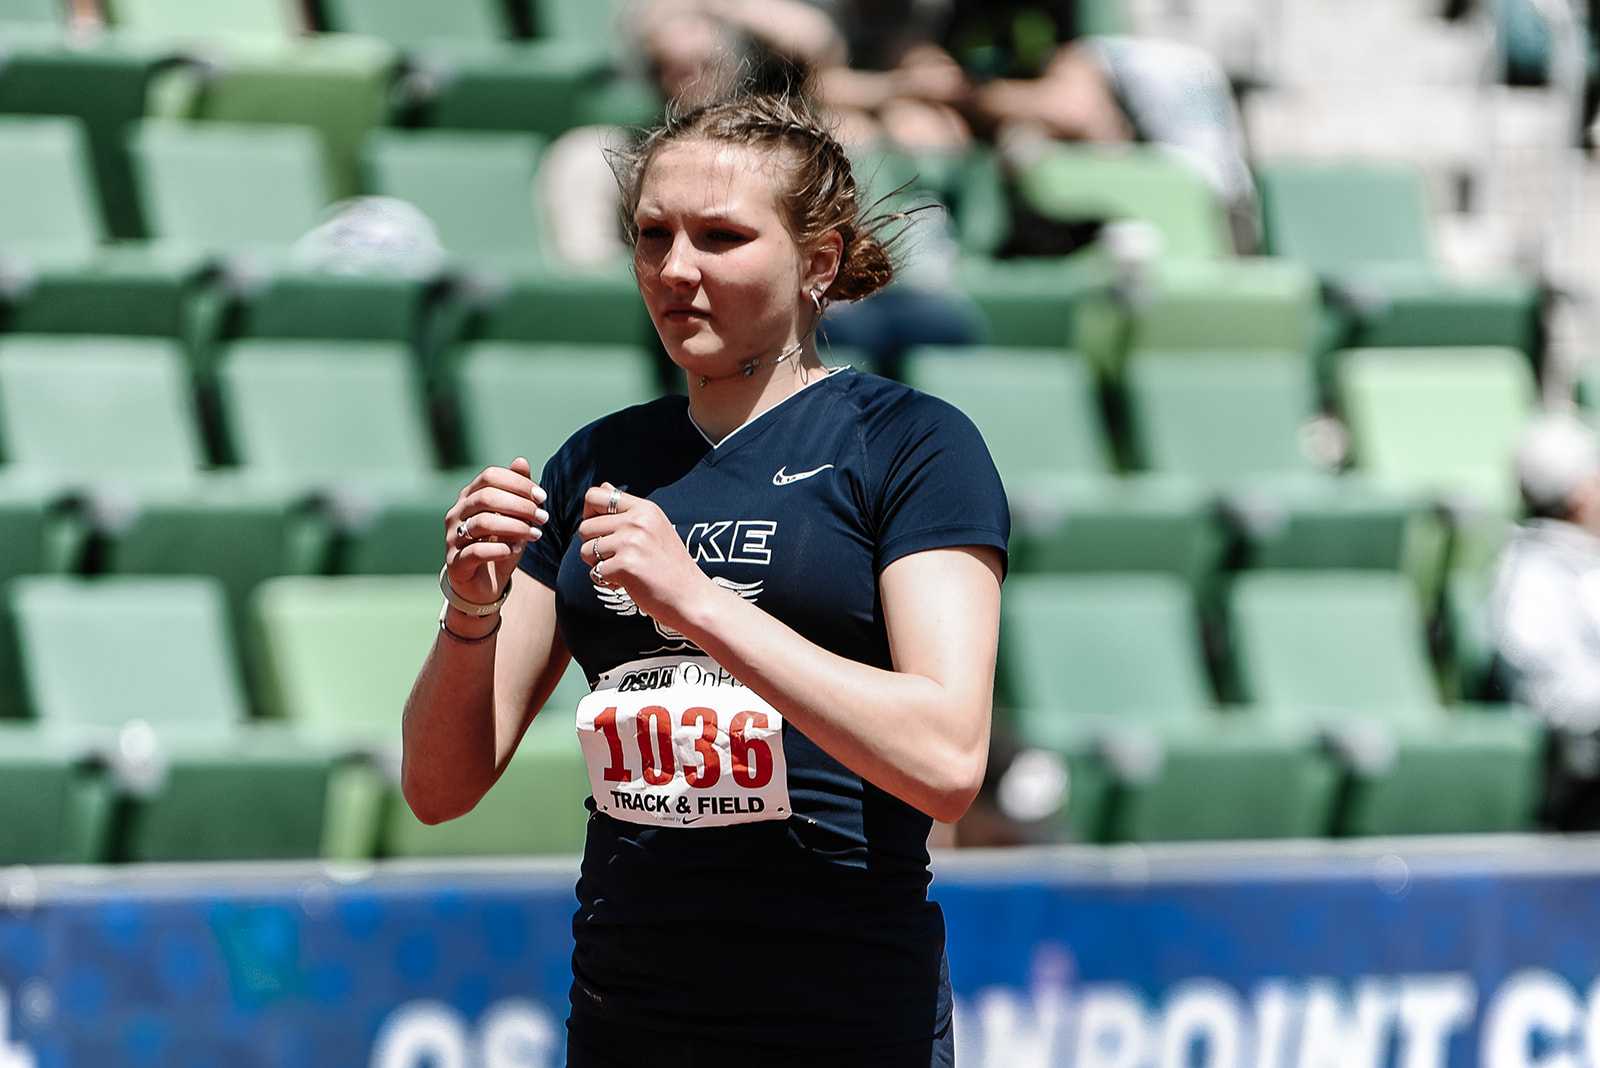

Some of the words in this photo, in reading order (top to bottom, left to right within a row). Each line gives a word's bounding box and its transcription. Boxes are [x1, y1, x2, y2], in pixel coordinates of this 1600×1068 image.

[672, 520, 777, 565] KE
[593, 705, 774, 789] 1036
[610, 790, 670, 814] TRACK
[676, 796, 694, 814] &
[698, 797, 765, 815] FIELD
